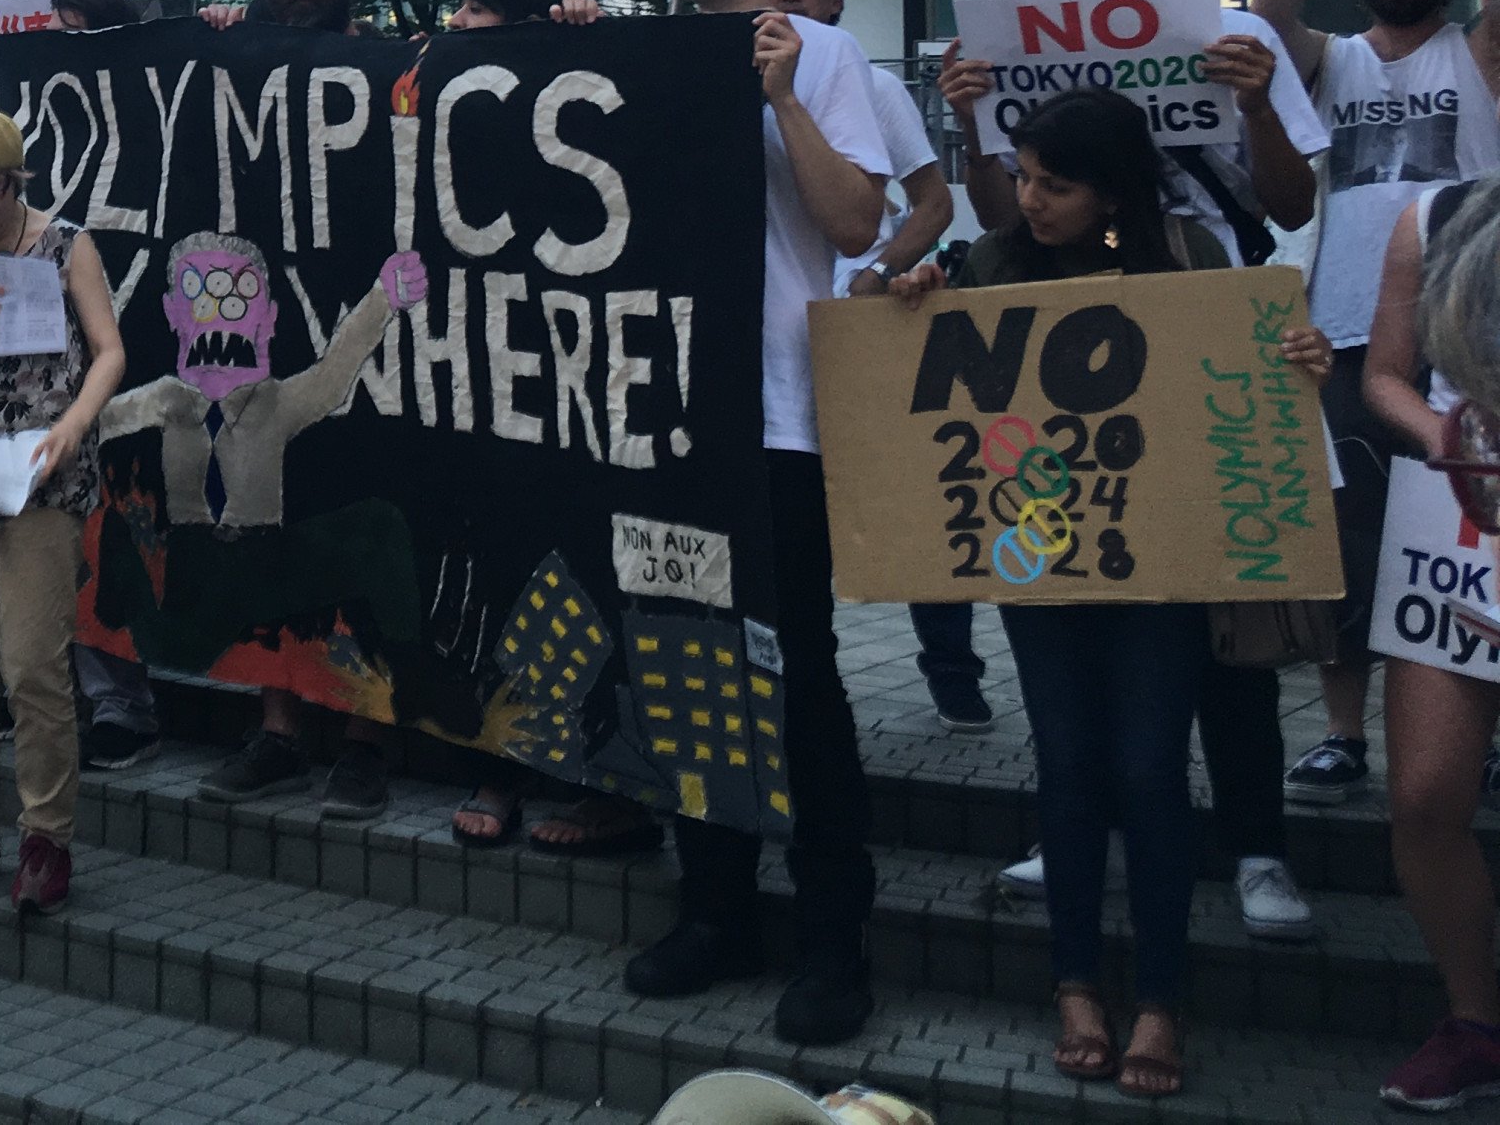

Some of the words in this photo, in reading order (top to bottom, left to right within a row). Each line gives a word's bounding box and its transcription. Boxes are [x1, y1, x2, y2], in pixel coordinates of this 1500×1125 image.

[994, 95, 1220, 137] Olics
[909, 304, 1148, 415] NO
[664, 532, 706, 559] AUX
[1394, 594, 1500, 666] Oly
